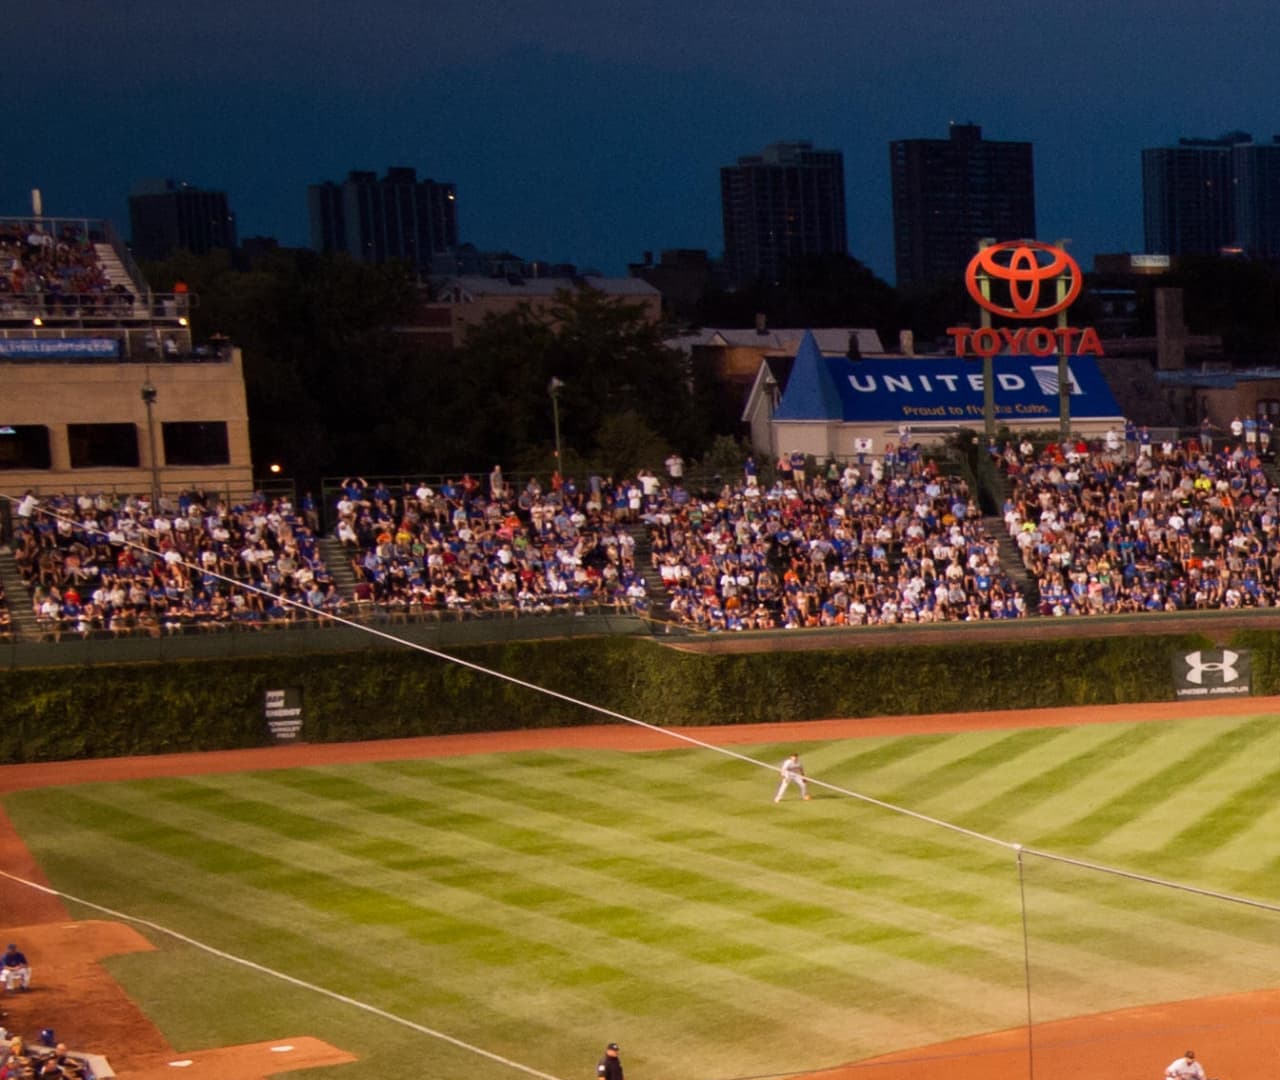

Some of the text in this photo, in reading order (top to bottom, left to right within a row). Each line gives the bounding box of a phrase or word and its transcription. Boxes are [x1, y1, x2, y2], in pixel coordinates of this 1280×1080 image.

[946, 327, 1104, 356] TOYOTA
[848, 373, 1025, 393] UNITED
[903, 406, 945, 416] Proud
[950, 406, 964, 415] to
[1176, 686, 1248, 696] UNDER ARMOUR
